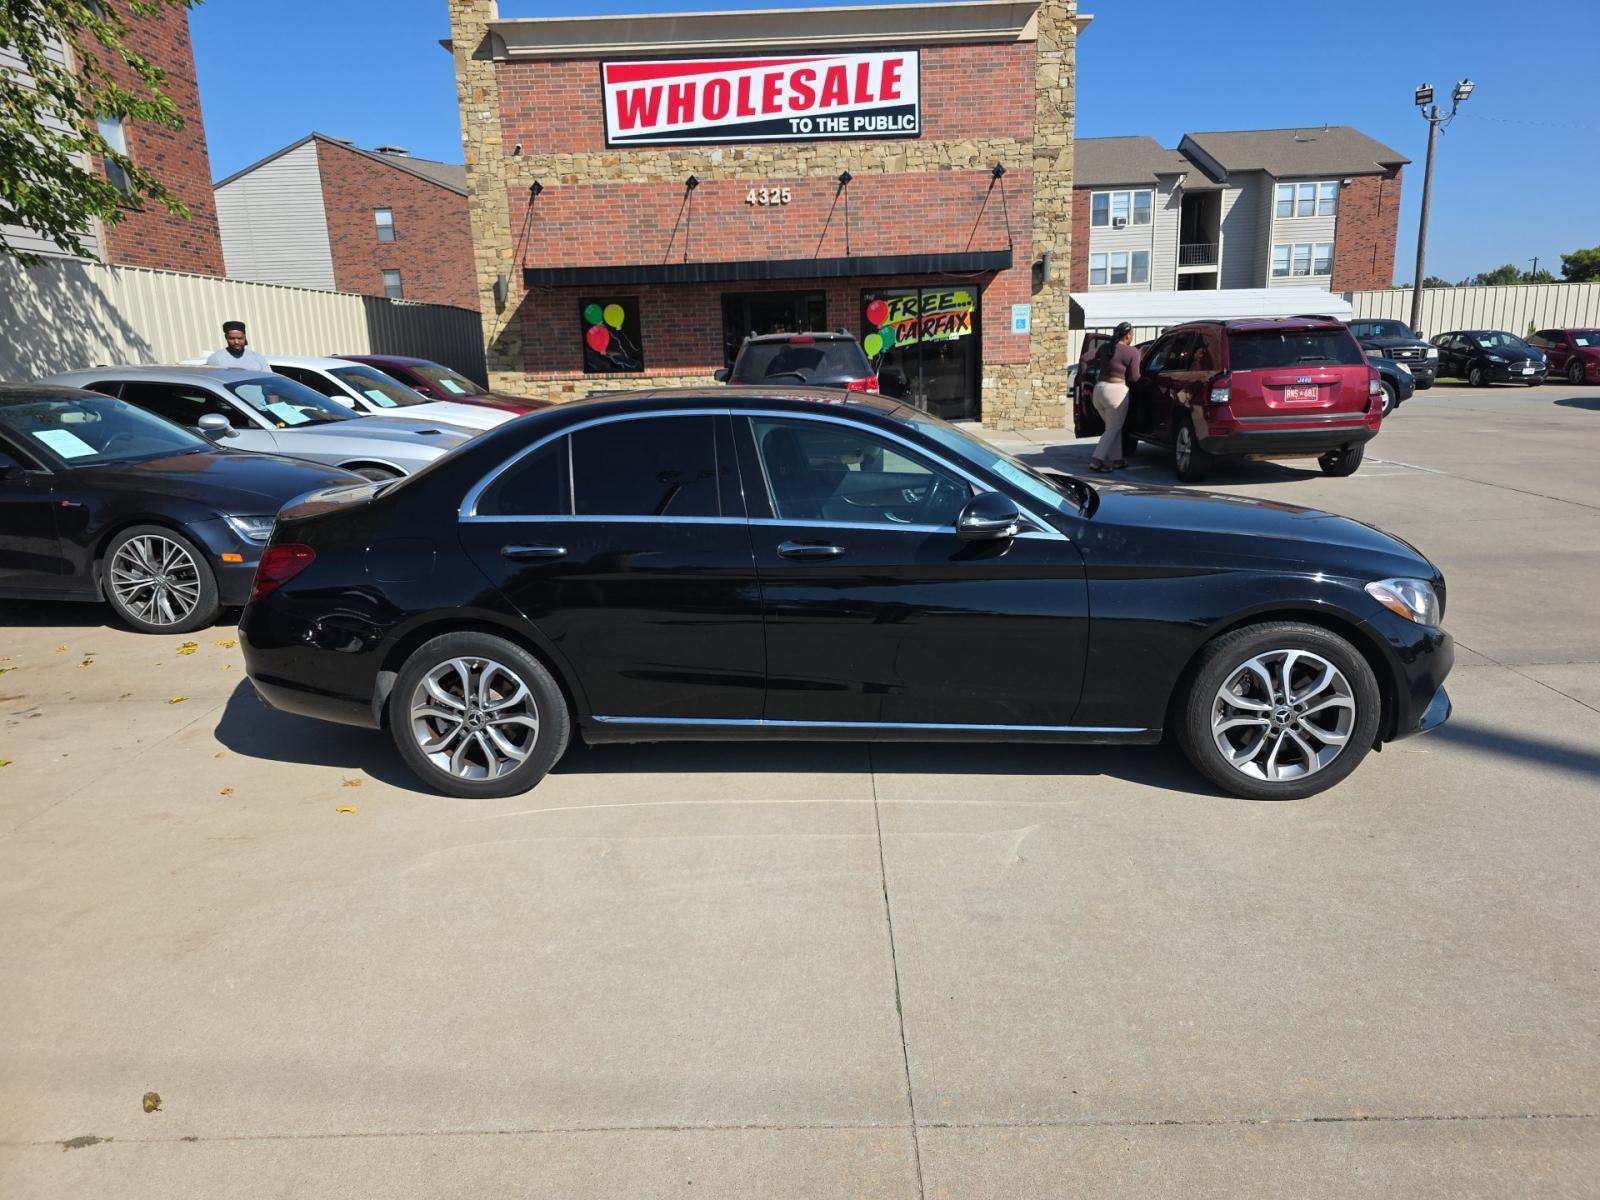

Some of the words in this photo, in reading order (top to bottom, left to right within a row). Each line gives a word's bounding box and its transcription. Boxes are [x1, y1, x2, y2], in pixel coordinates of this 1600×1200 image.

[615, 57, 904, 131] WHOLESALE
[789, 118, 813, 133] TO
[816, 117, 850, 132] THE
[853, 114, 915, 131] PUBLIC
[745, 187, 792, 206] 4325
[895, 309, 970, 343] CARFAX
